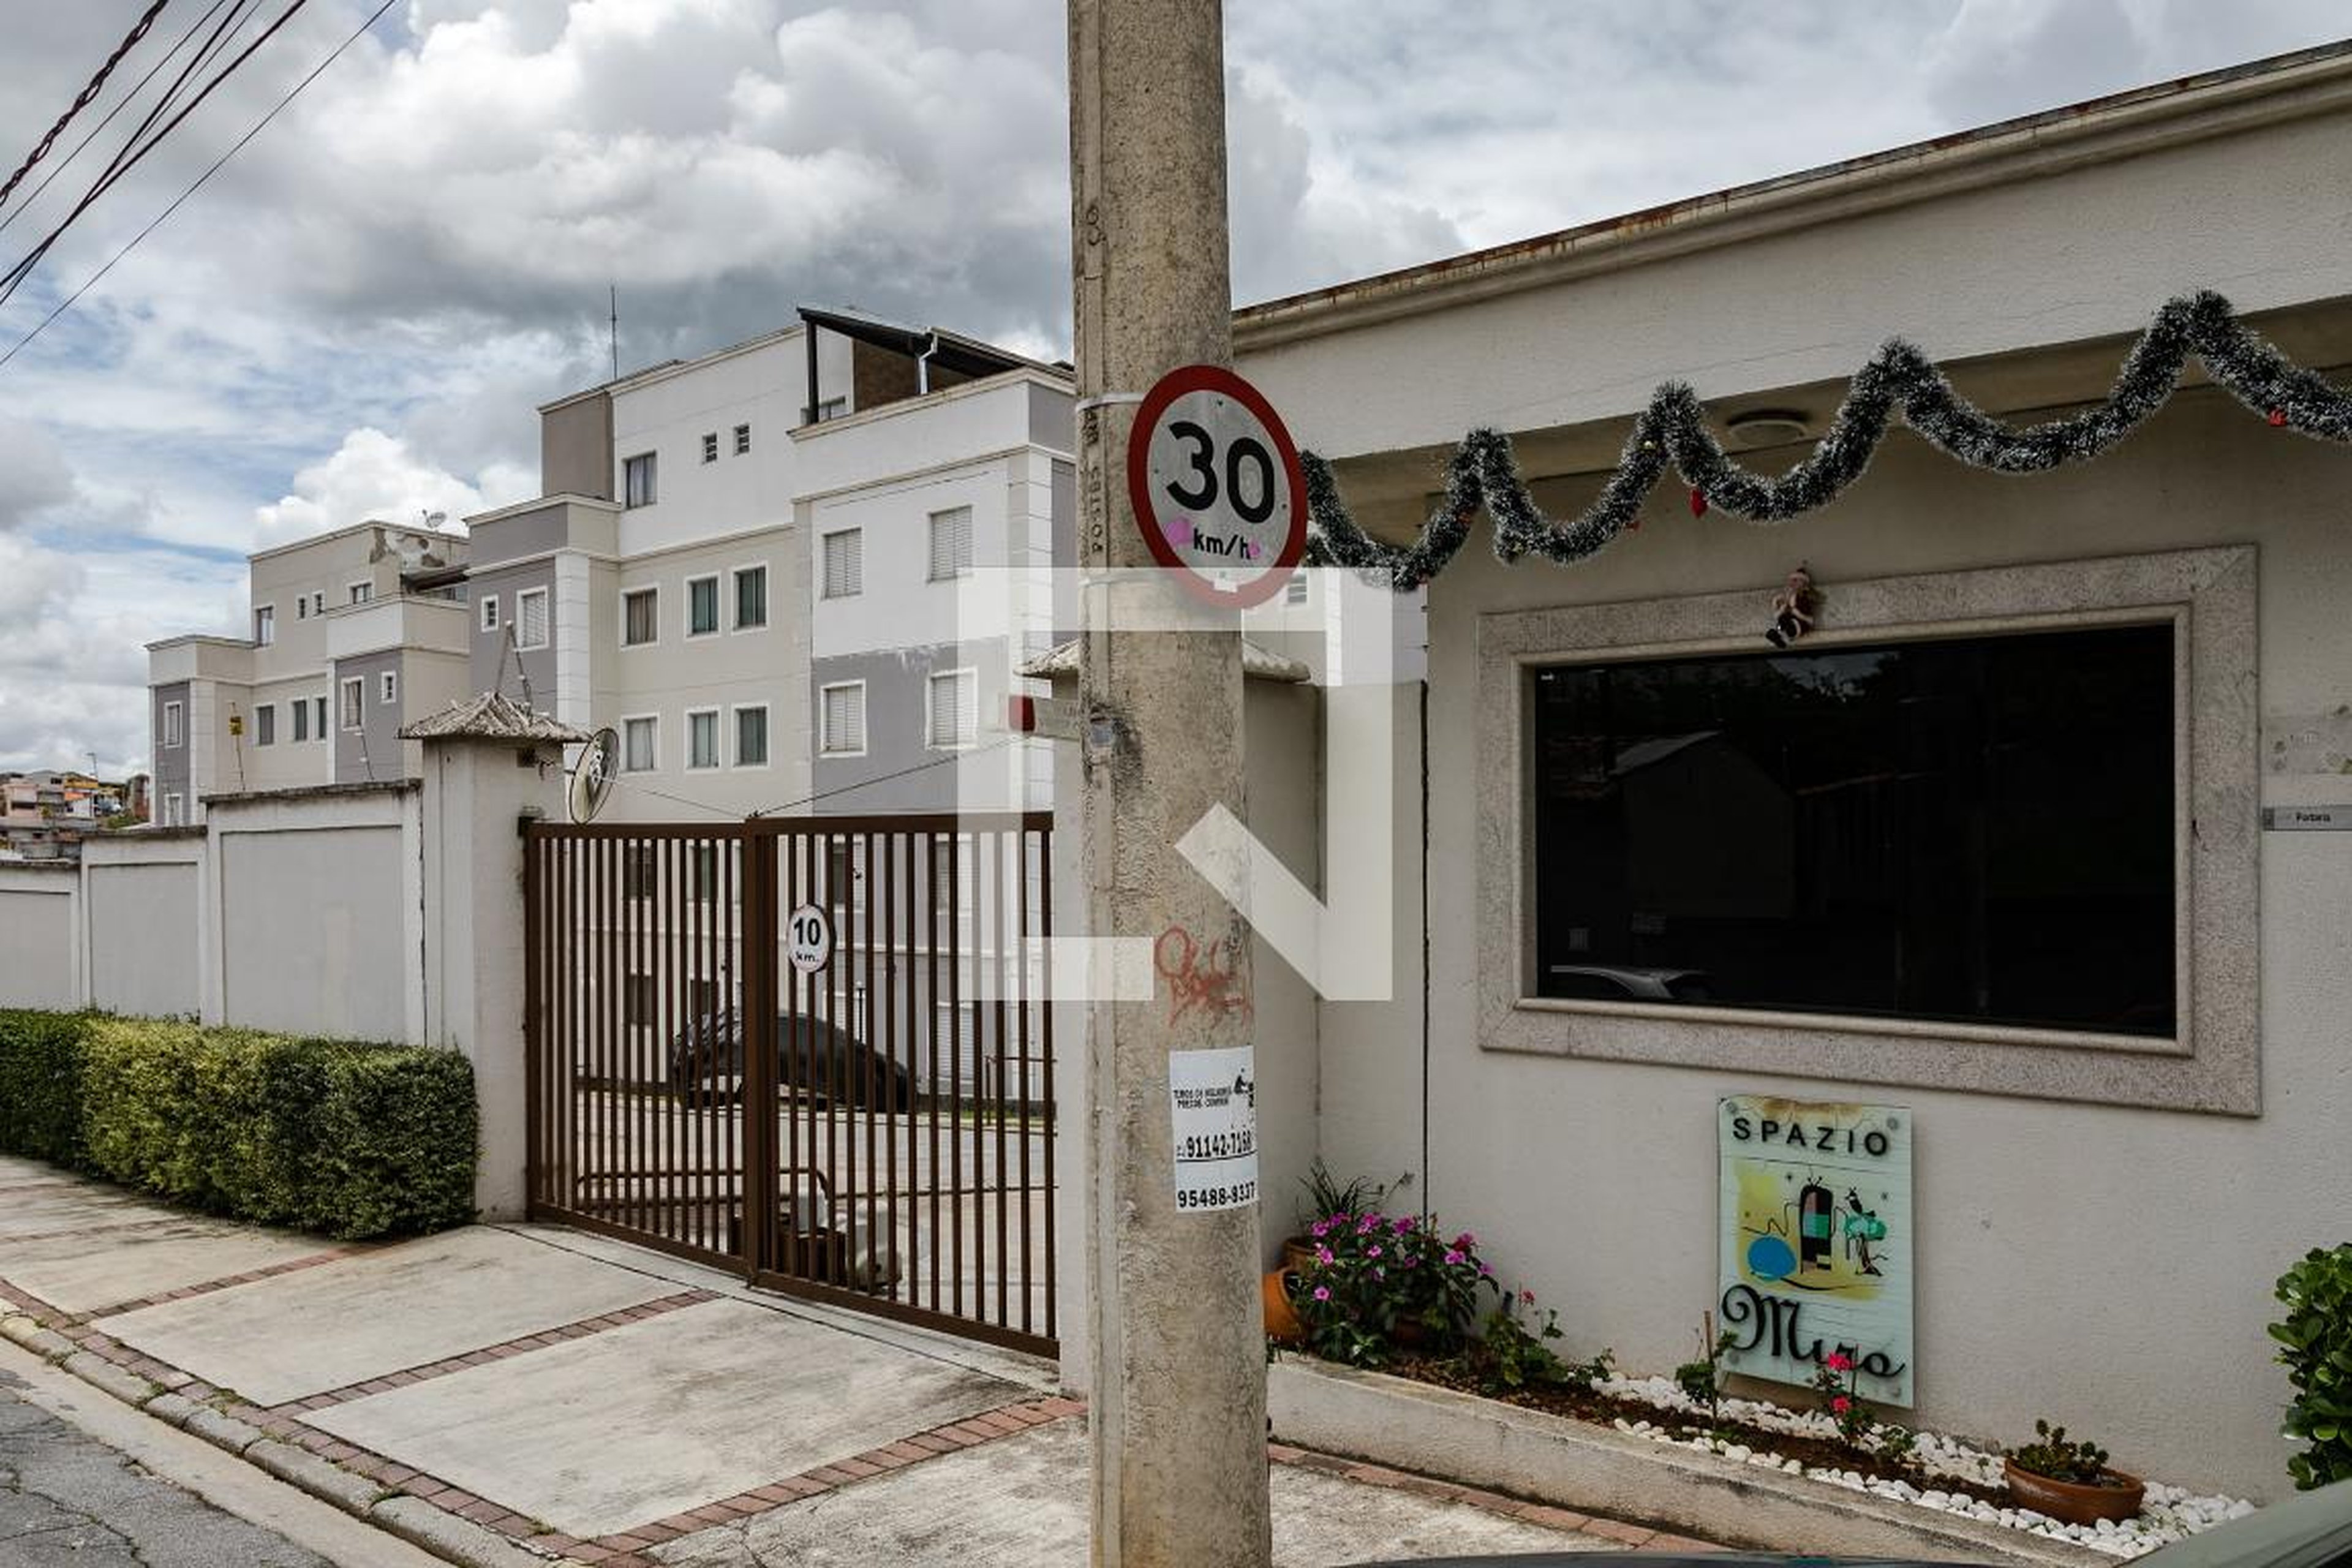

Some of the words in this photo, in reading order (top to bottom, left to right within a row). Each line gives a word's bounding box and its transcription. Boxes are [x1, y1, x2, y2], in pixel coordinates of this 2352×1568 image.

[1166, 421, 1275, 524] 30
[1194, 527, 1251, 560] km/h
[794, 918, 820, 946] 10
[1732, 1118, 1888, 1156] SPAZIO
